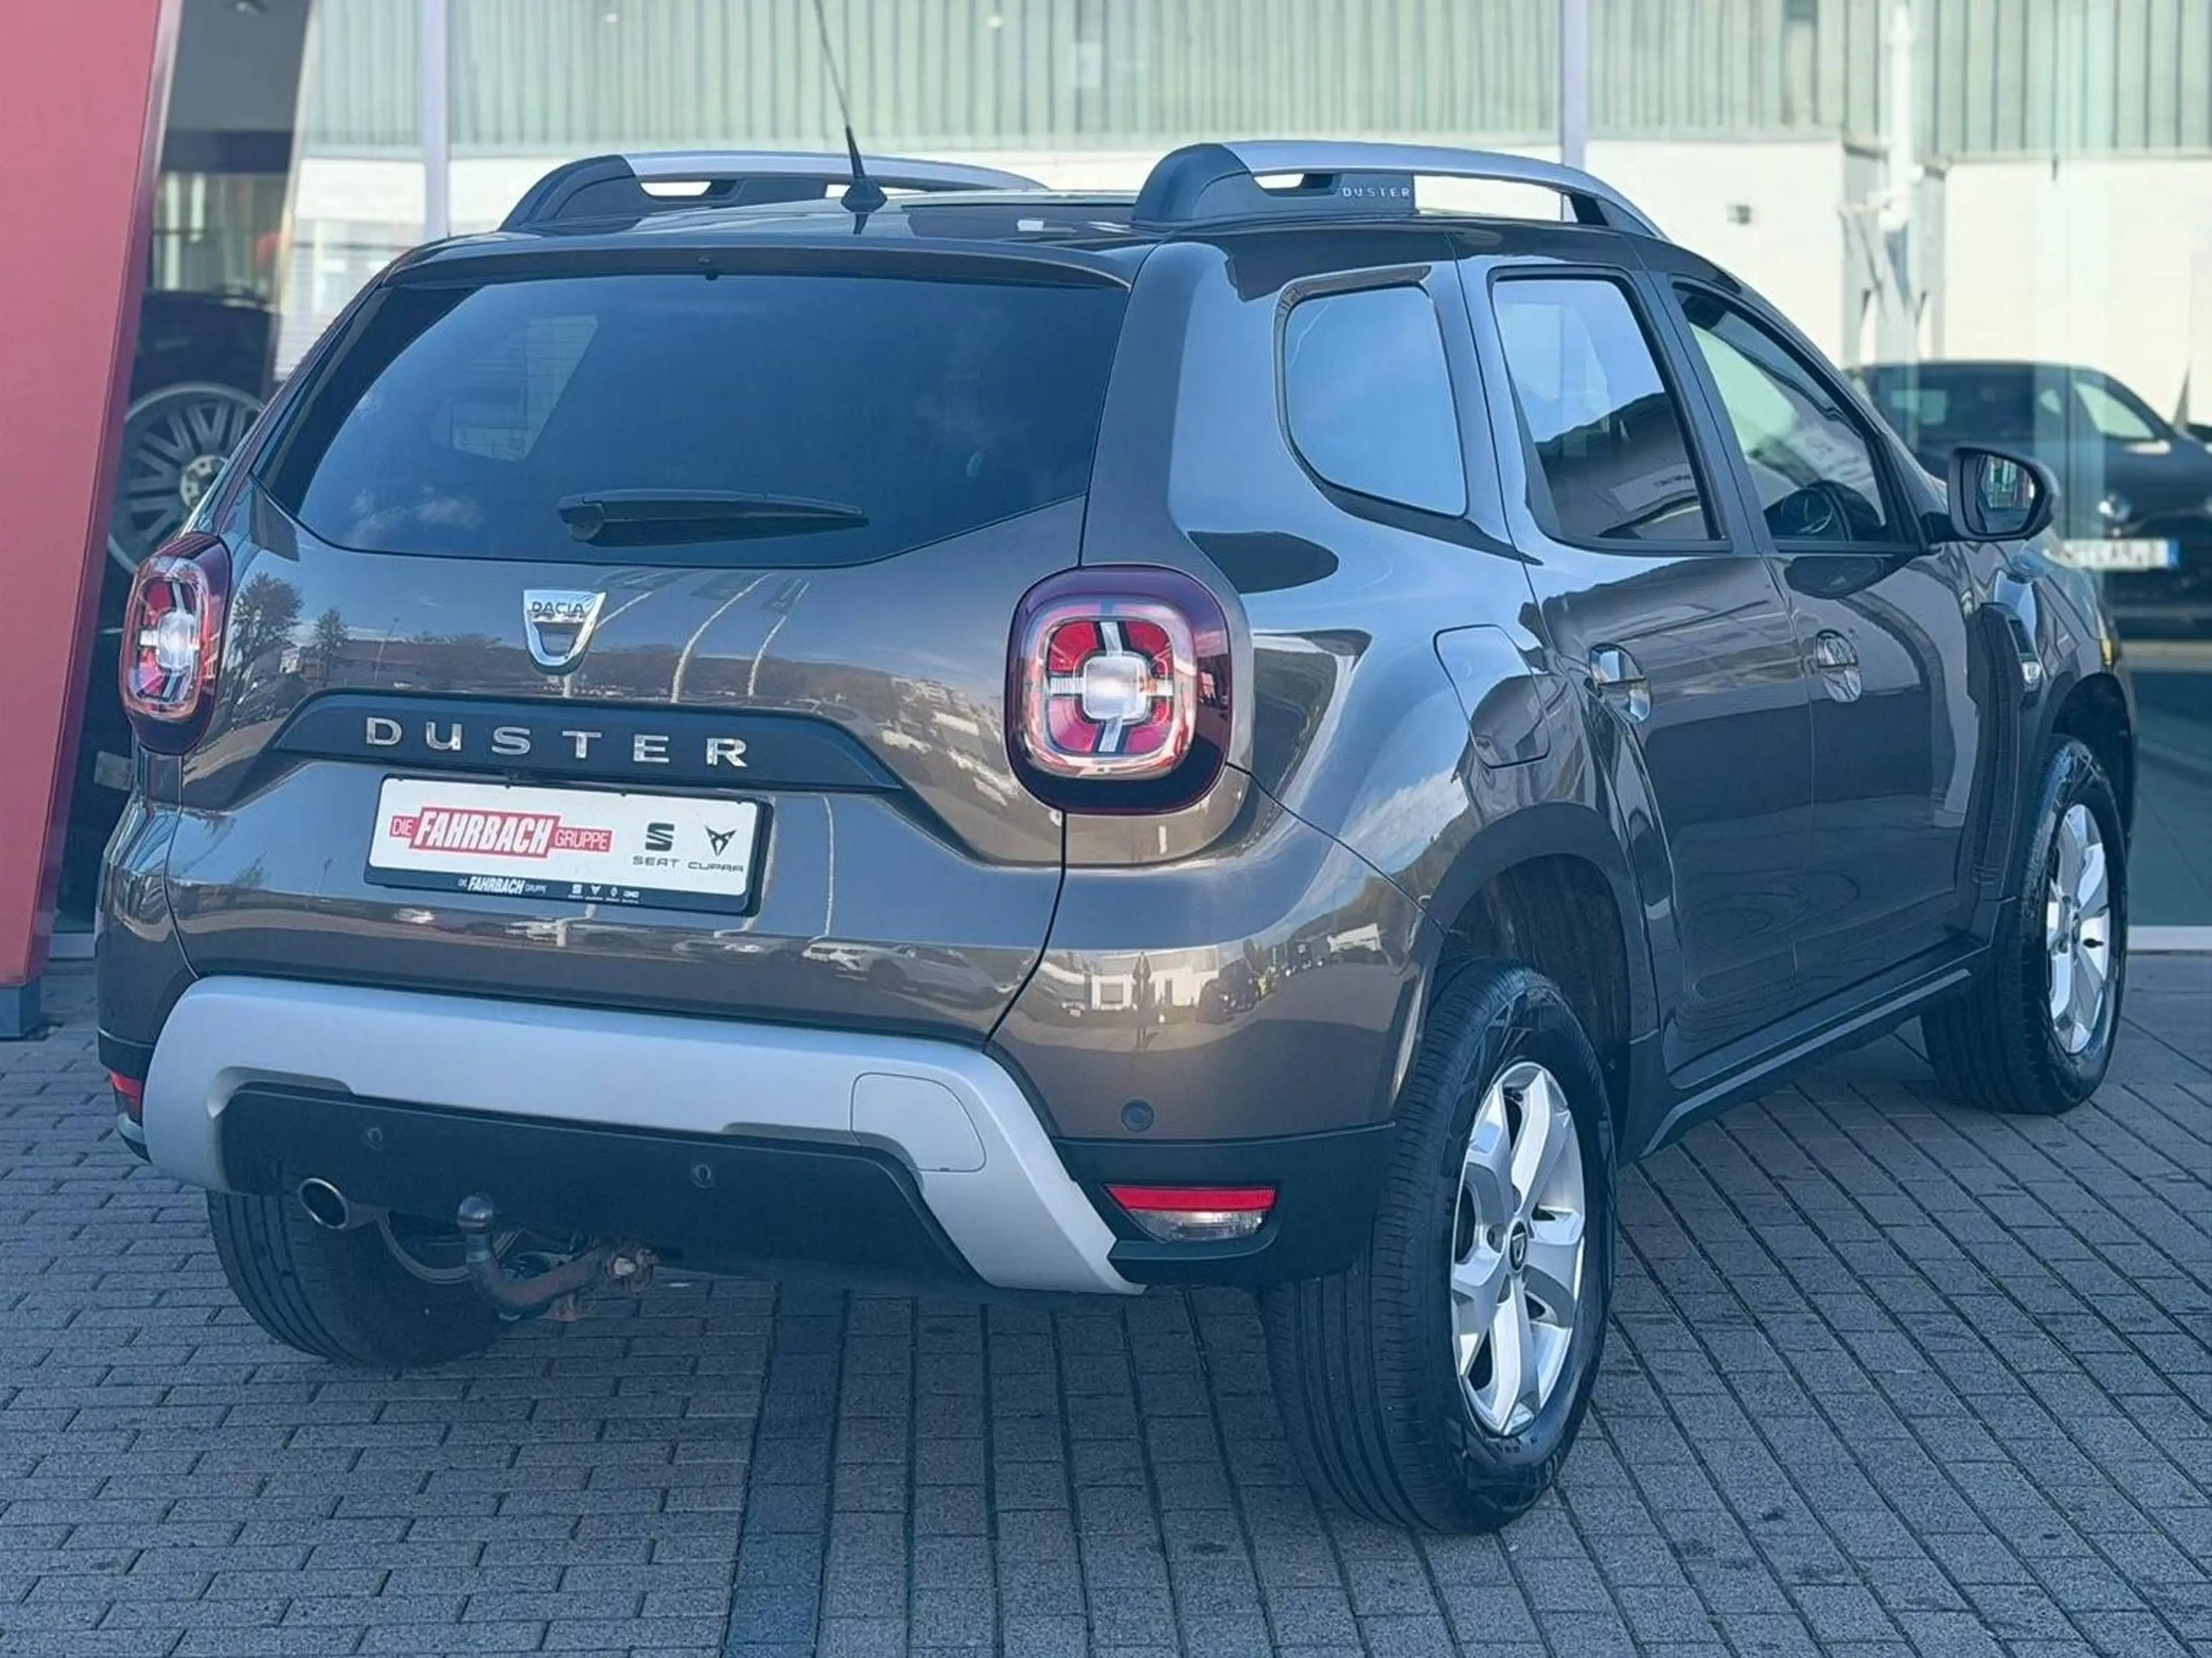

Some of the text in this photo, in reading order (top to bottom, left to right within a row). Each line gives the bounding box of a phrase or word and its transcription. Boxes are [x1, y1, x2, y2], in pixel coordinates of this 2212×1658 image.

[1342, 187, 1410, 198] DUSTER
[531, 601, 585, 614] DACIA
[366, 717, 748, 768] DUSTER
[392, 811, 610, 854] DIE FAHRBACH GRUPPE
[633, 855, 680, 869] SEAT
[687, 861, 744, 872] CUPRA
[468, 876, 526, 895] FAHRBACH
